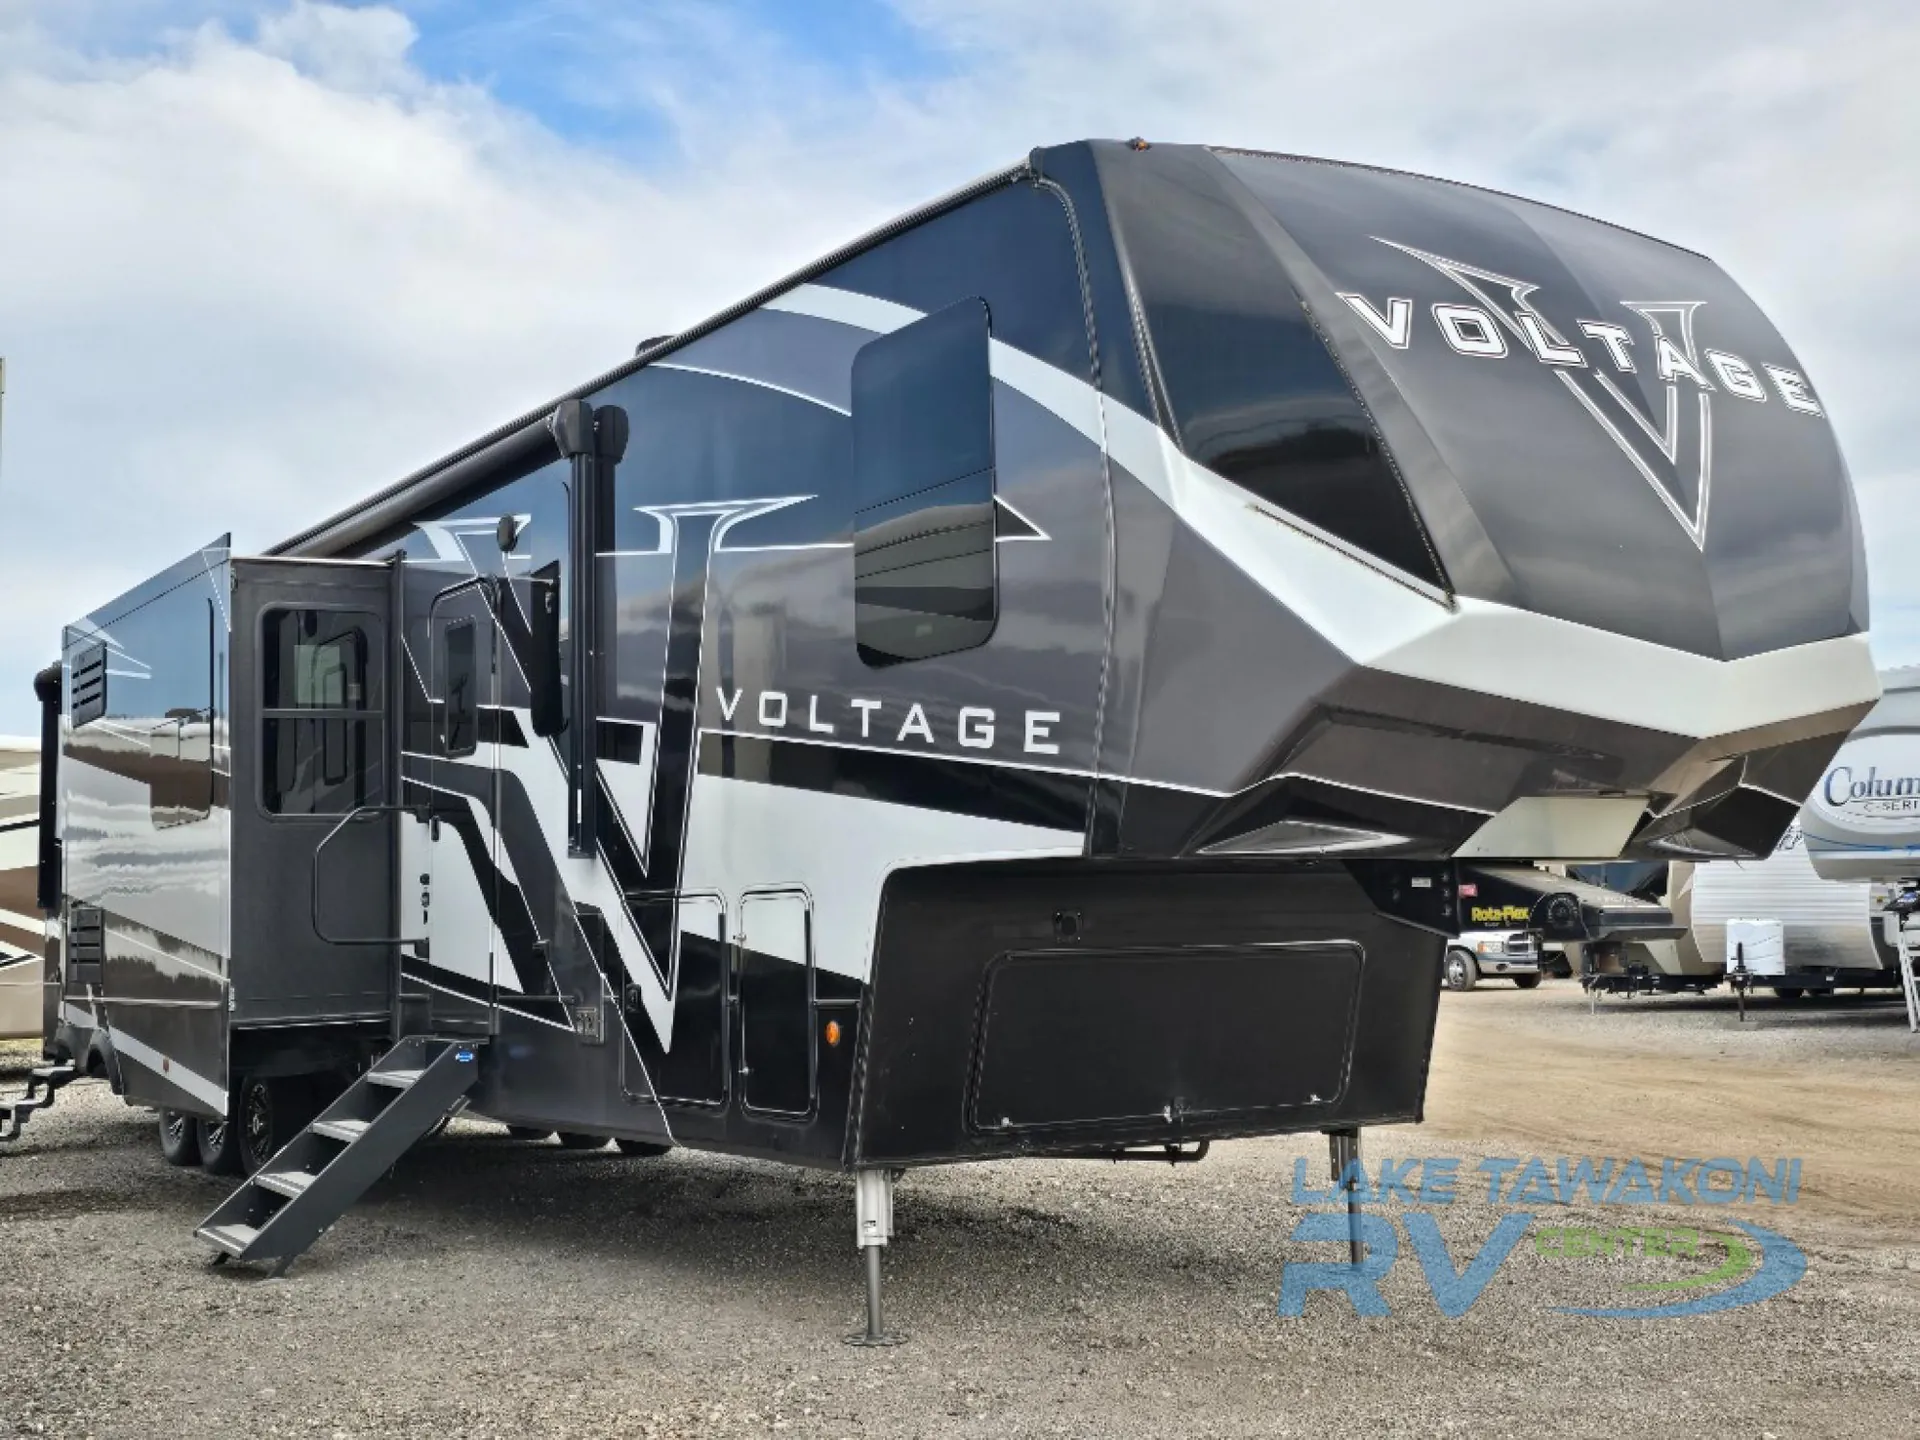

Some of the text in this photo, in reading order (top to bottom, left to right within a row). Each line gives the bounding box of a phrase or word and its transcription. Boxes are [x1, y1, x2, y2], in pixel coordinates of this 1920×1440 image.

[1335, 291, 1825, 418] VOLTAGE
[716, 686, 1061, 755] VOLTAGE
[1471, 905, 1529, 922] Rota-Flex
